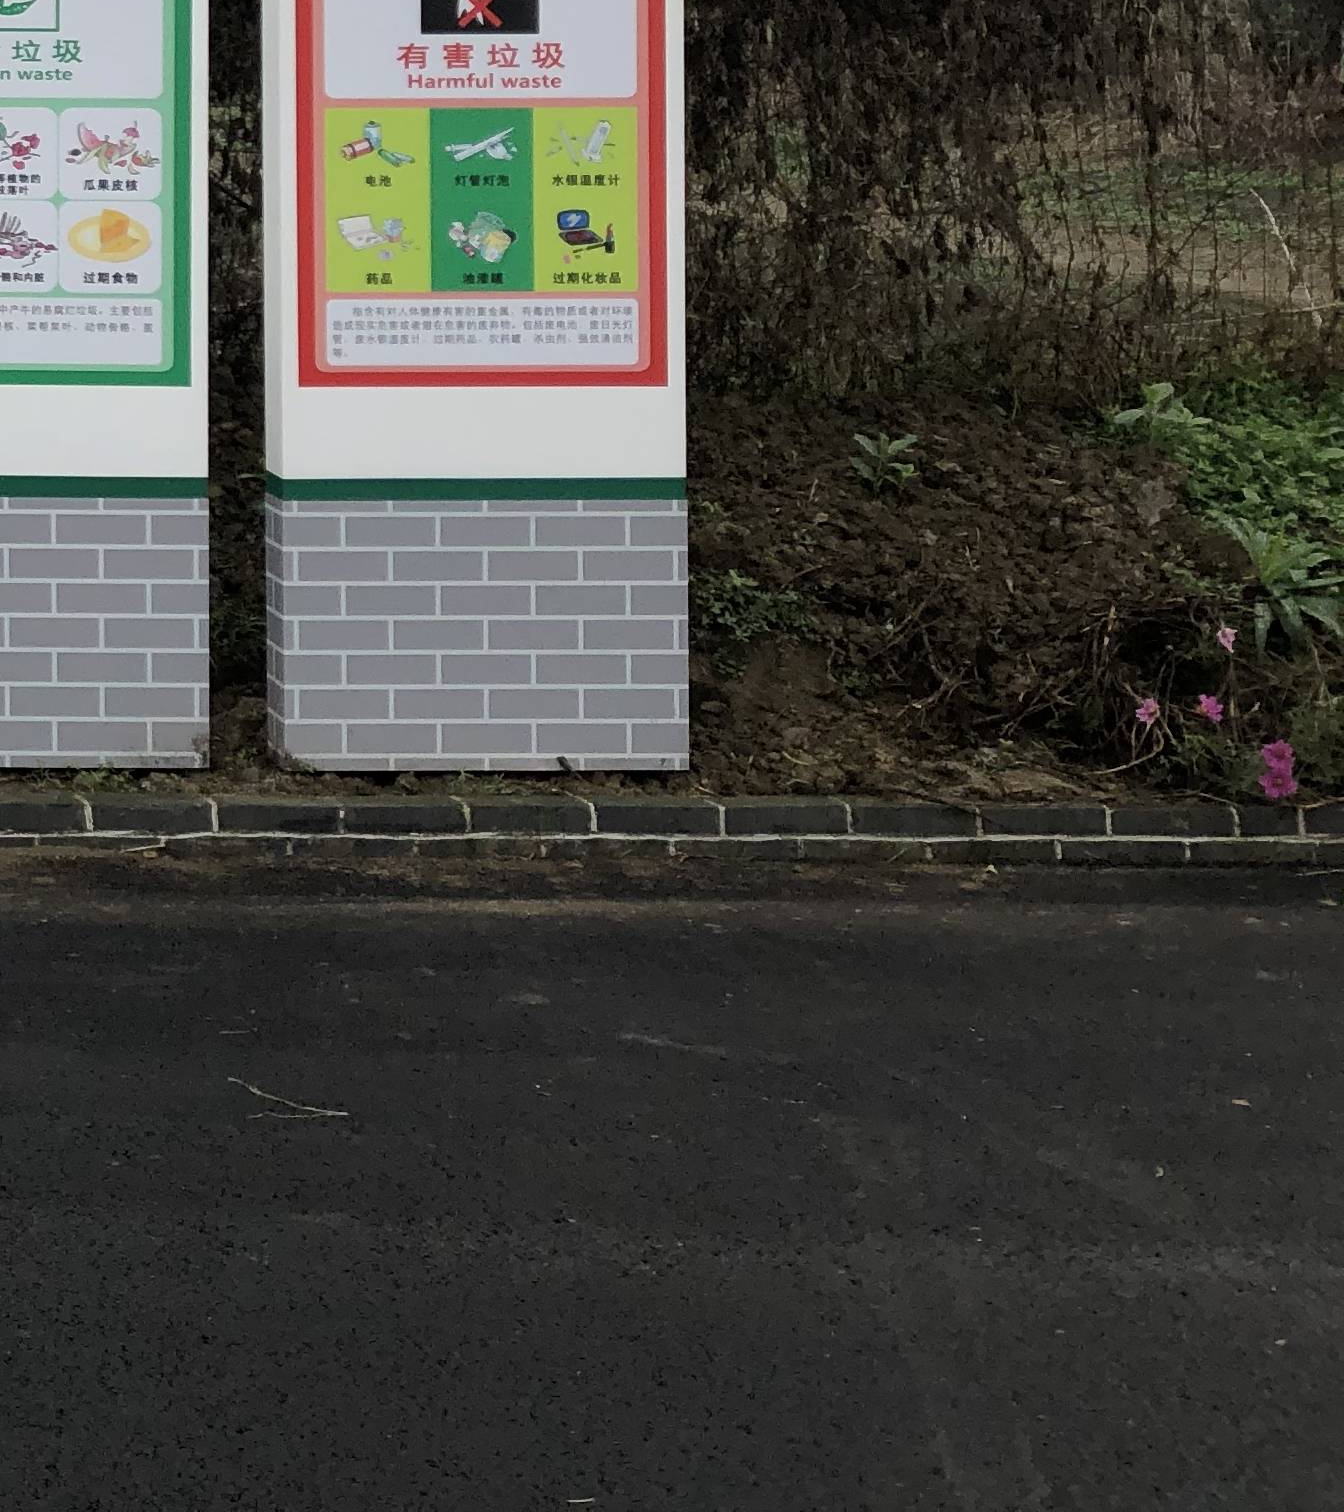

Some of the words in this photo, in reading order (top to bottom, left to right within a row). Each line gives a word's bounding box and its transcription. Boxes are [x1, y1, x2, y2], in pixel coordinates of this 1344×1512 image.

[396, 42, 565, 70] 有害垃圾
[16, 68, 73, 81] waste
[407, 72, 494, 89] Harmful
[500, 74, 562, 89] waste
[83, 179, 138, 192] 瓜果皮核
[365, 174, 392, 188] 电池
[551, 173, 620, 187] 水银温度计
[83, 271, 138, 285] 过期食物
[365, 272, 393, 286] 药品
[553, 271, 622, 285] 过期化妆品
